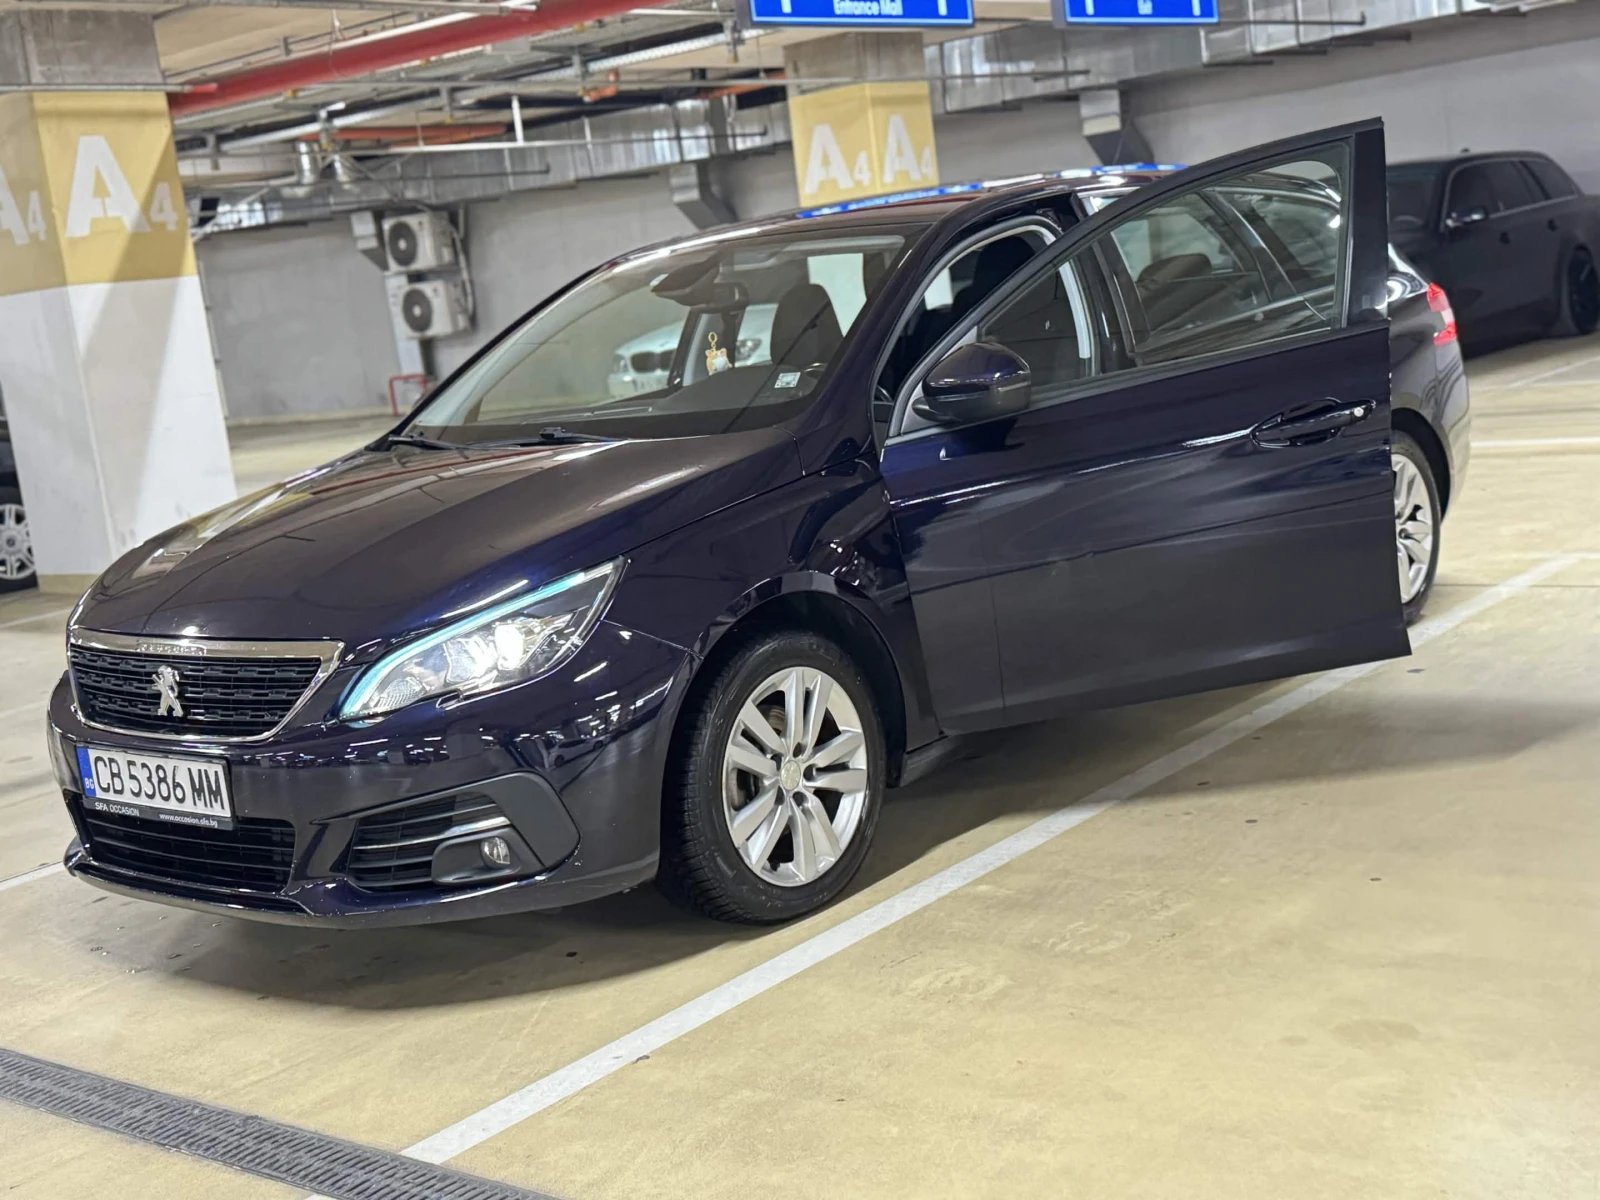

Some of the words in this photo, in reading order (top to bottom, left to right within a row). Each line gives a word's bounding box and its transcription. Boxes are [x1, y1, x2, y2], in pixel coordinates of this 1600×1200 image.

[65, 135, 178, 238] A4
[804, 124, 872, 195] A4
[84, 777, 95, 790] BG
[94, 755, 125, 796] CB
[127, 759, 186, 804] 5386
[188, 767, 226, 811] MM
[95, 802, 109, 812] SFA
[109, 804, 140, 817] OCCASION
